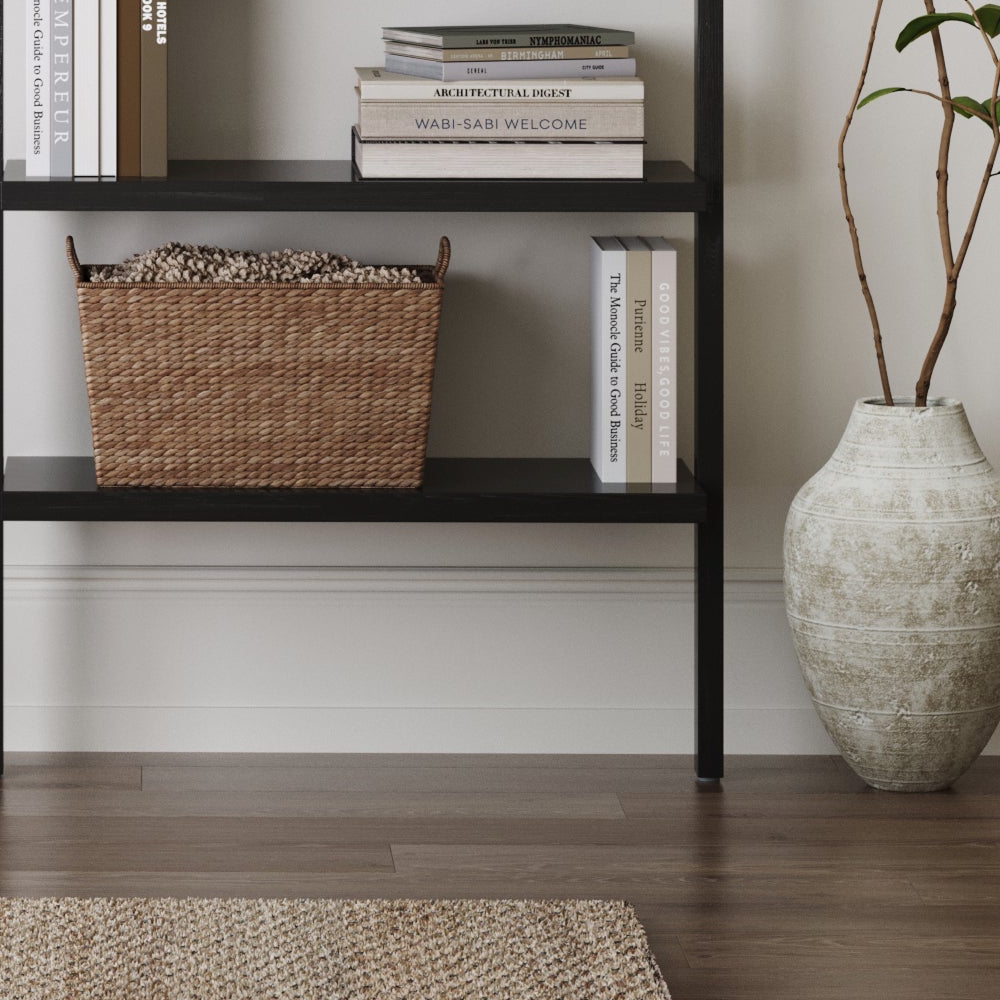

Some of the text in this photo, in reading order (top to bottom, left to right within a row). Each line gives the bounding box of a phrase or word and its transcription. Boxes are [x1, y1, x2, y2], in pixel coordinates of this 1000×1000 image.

[142, 23, 153, 31] 9
[156, 2, 167, 45] HOTELS
[33, 29, 44, 61] Guide
[500, 51, 564, 60] BIRMINGHAM
[529, 36, 602, 46] NYMPHOMANIAC
[33, 65, 42, 74] to
[33, 78, 44, 107] Good
[434, 88, 572, 98] ARCHITECTURAL DIGEST
[33, 110, 44, 155] Business
[415, 118, 587, 130] WABI-SABI WELCOME
[658, 282, 670, 325] GOOD
[610, 273, 621, 463] The Monocle Guide to Good Business
[631, 299, 647, 430] Purienne Holiday
[658, 377, 670, 420] GOOD
[658, 425, 670, 457] LIFE
